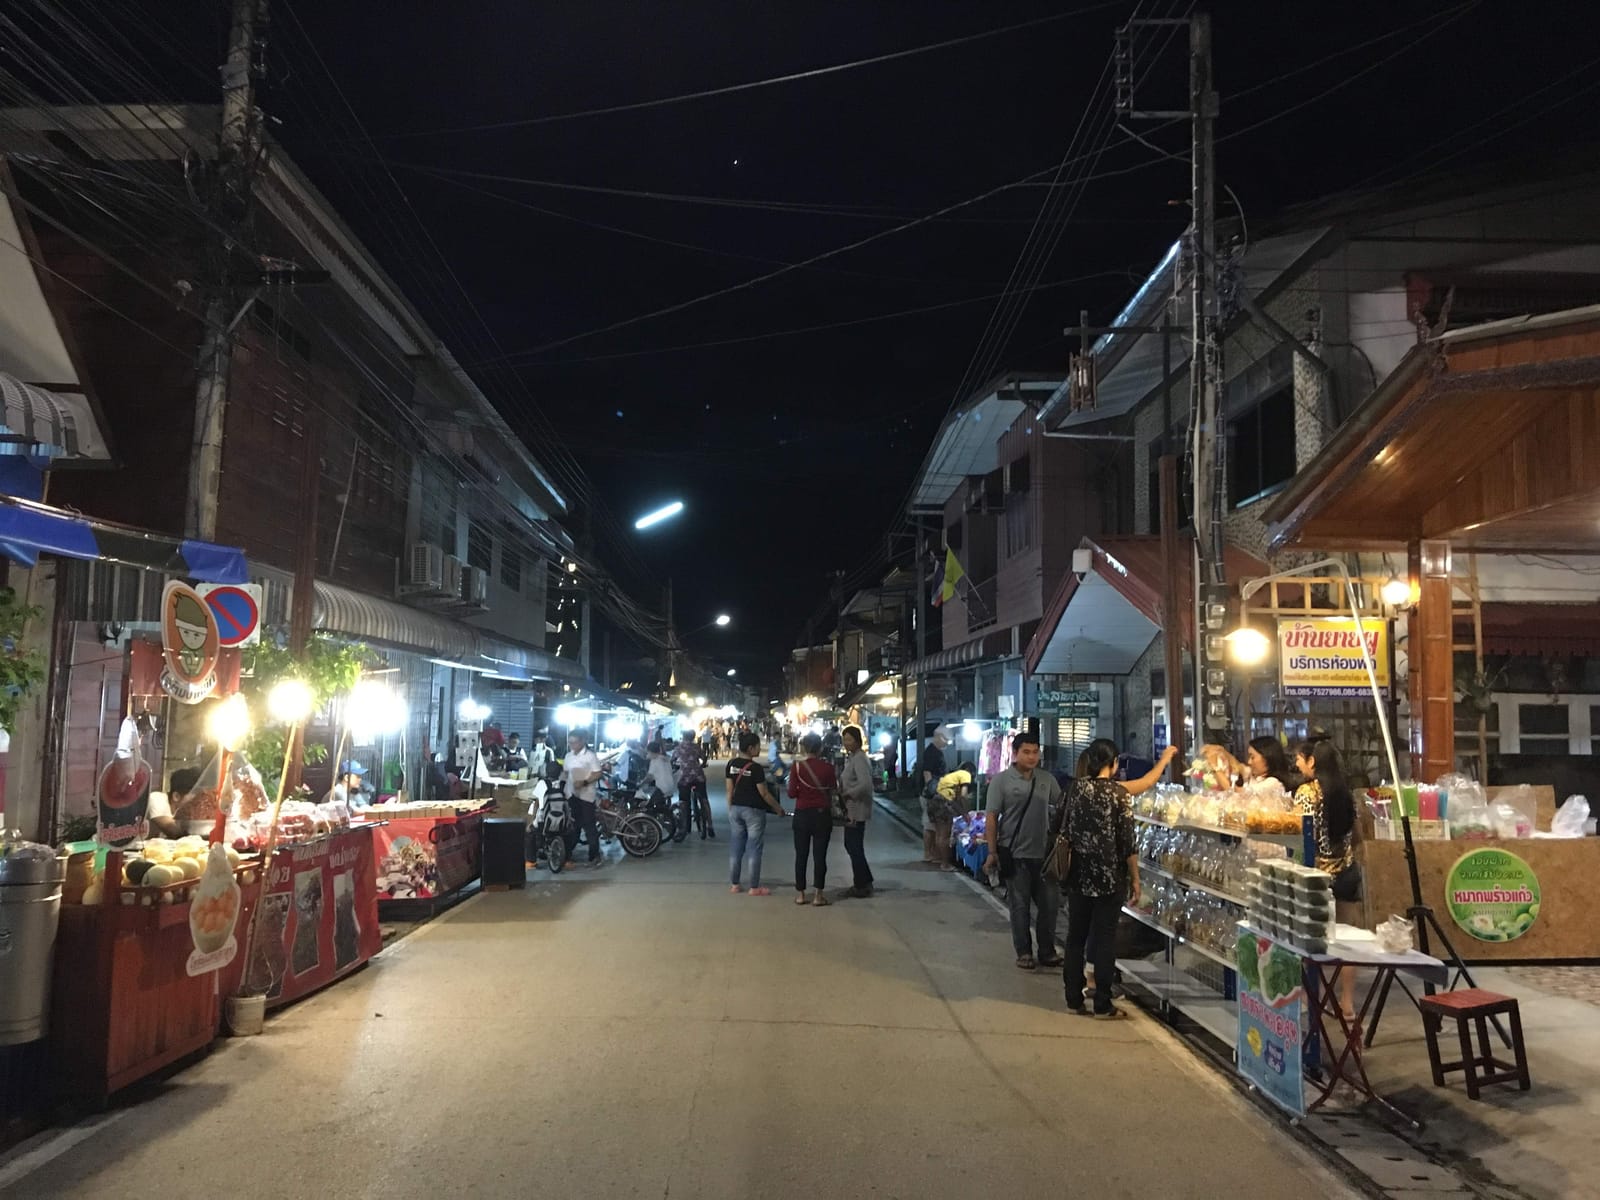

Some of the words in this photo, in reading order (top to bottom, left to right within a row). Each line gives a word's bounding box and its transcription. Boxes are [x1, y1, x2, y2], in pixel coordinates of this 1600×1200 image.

[1290, 655, 1377, 670] บริการห้องพก
[1454, 884, 1533, 903] หมากพร้าวแก้ว
